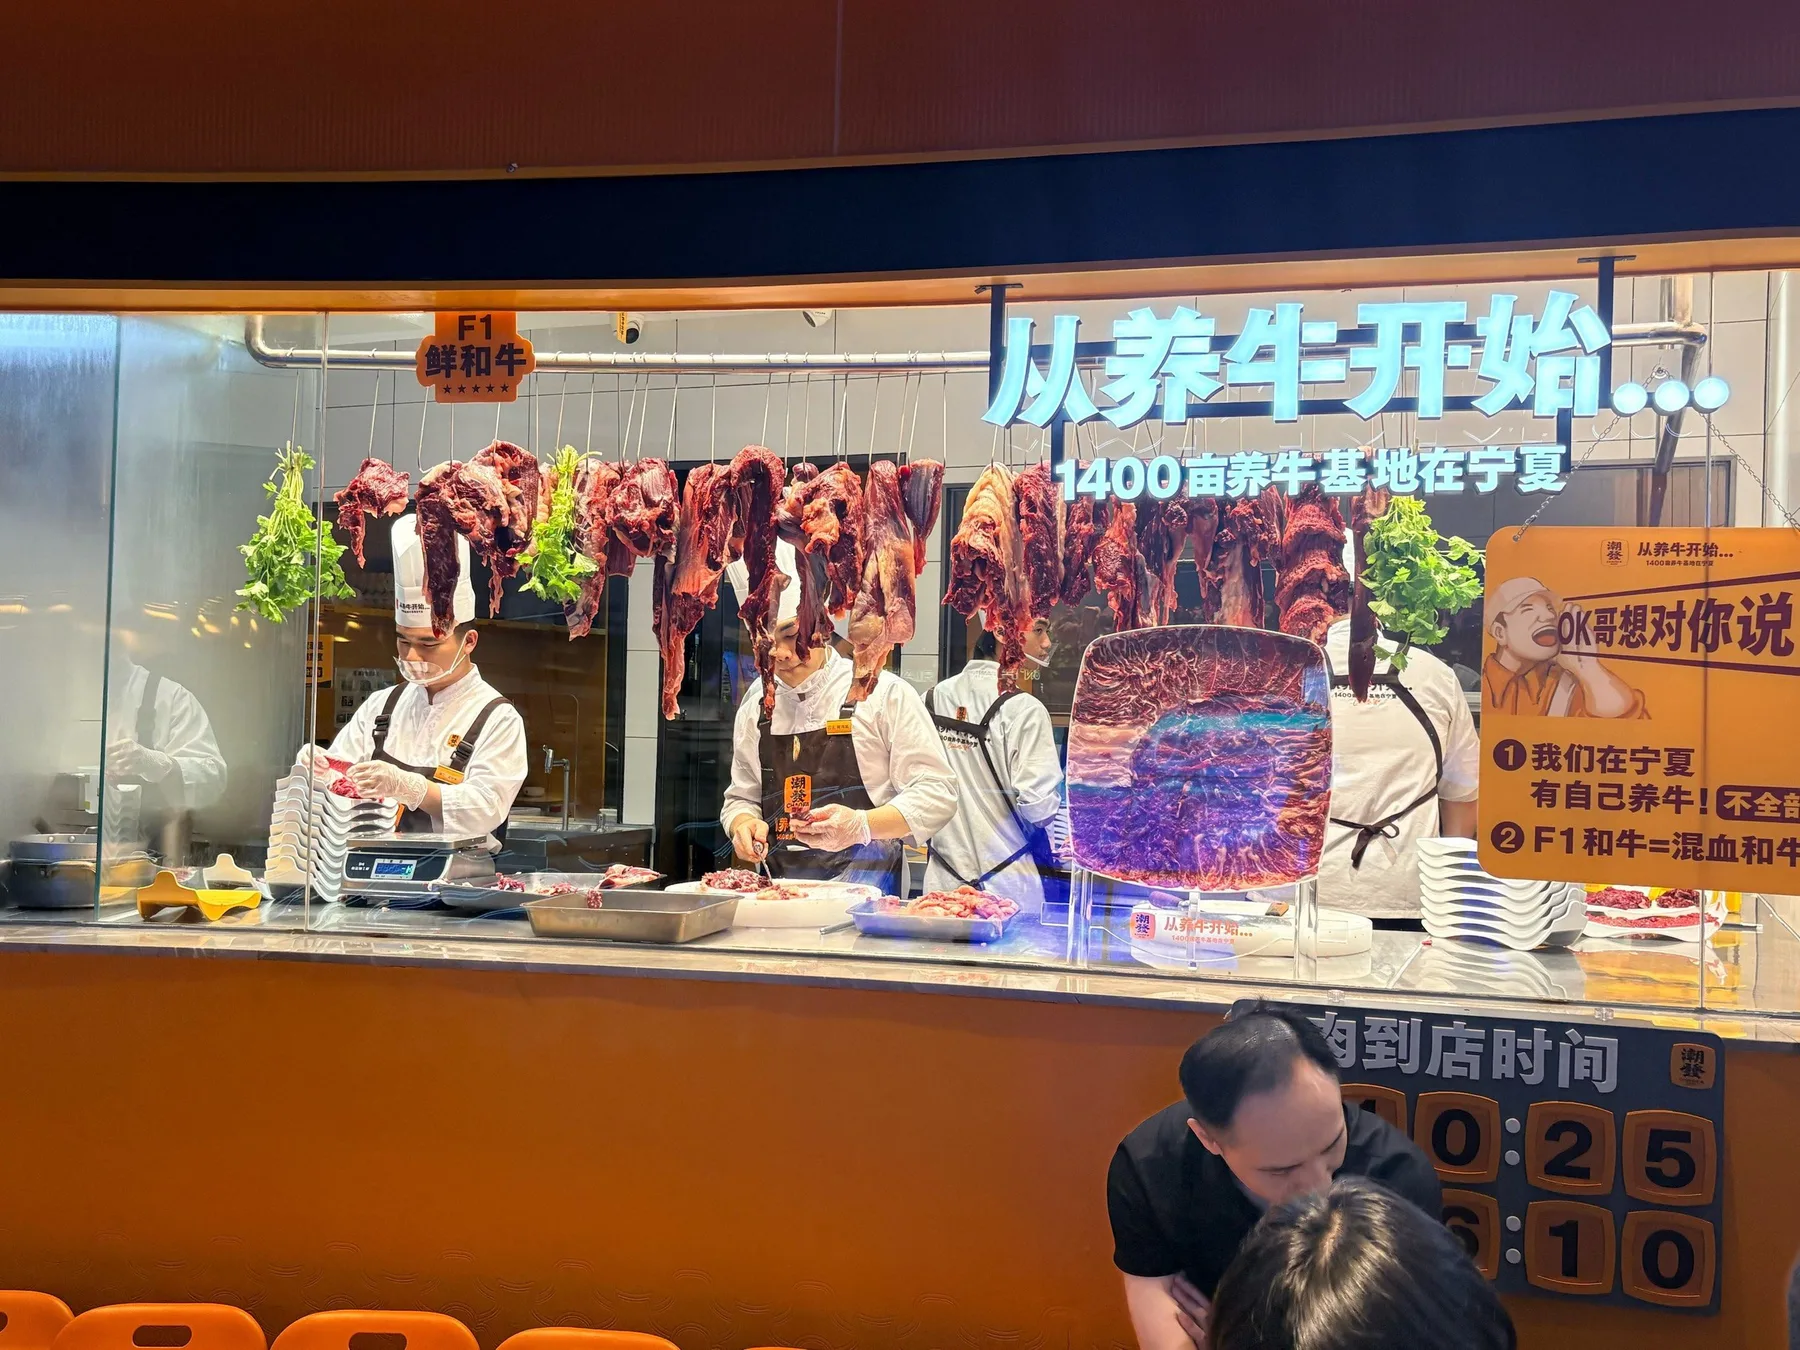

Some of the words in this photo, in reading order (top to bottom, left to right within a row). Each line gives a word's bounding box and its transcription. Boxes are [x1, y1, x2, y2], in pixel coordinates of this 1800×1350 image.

[458, 314, 492, 341] F1
[425, 343, 527, 378] 鲜和牛
[982, 290, 1730, 428] 从养牛开始...
[1056, 445, 1568, 501] 1400亩养牛基地在宁夏
[1637, 542, 1734, 558] 从养牛开始...
[1558, 592, 1795, 657] OK哥想对你说
[1531, 742, 1696, 777] 我们在宁夏
[1531, 780, 1709, 815] 有自己养牛!
[1534, 825, 1800, 867] F1和牛=混血和牛
